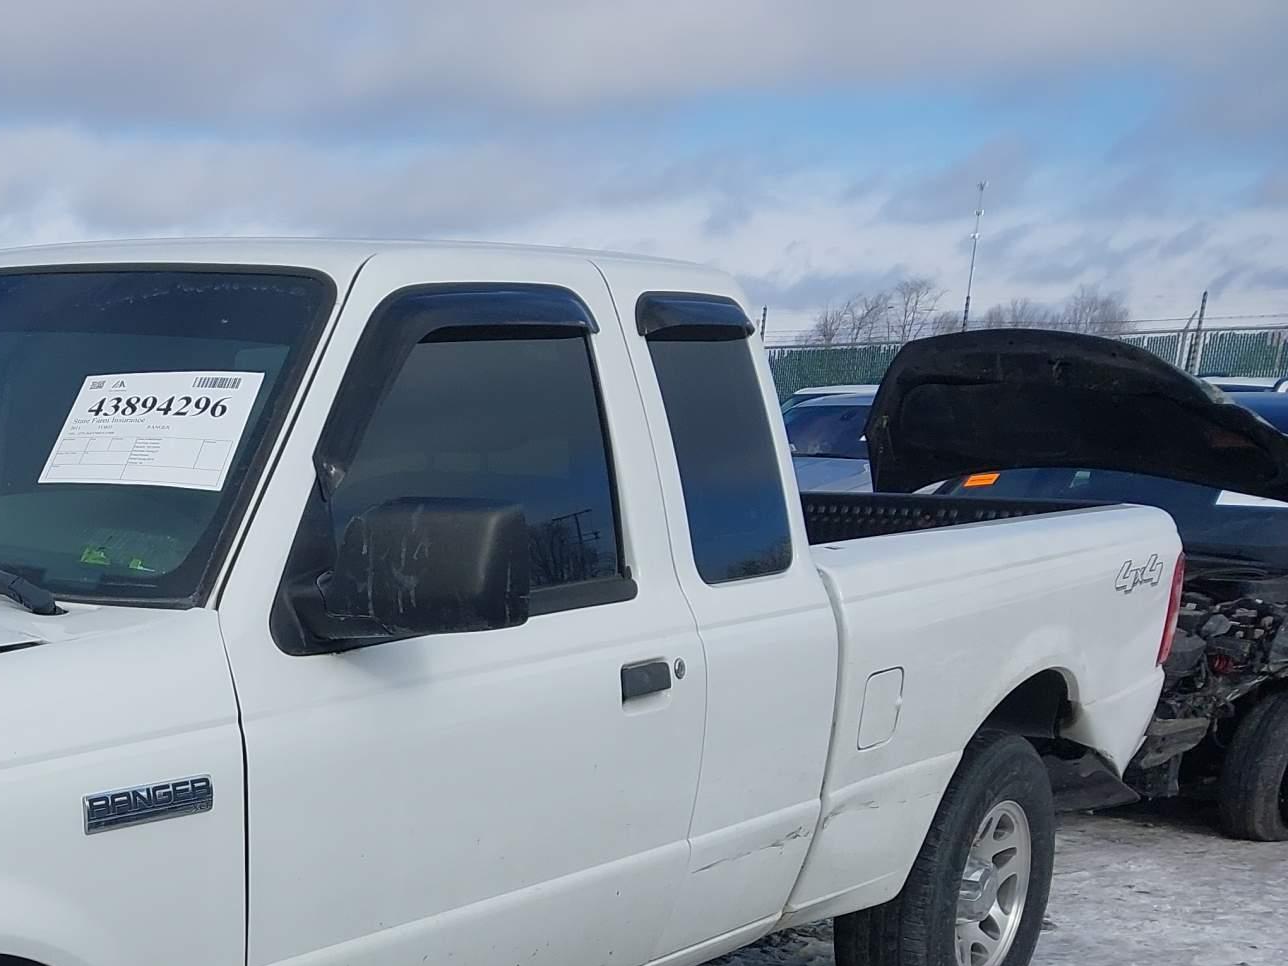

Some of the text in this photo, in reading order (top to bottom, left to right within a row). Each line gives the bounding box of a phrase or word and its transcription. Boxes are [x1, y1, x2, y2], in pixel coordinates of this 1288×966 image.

[88, 396, 232, 418] 43894296
[1115, 553, 1164, 595] 4x4
[87, 777, 210, 820] RANGER
